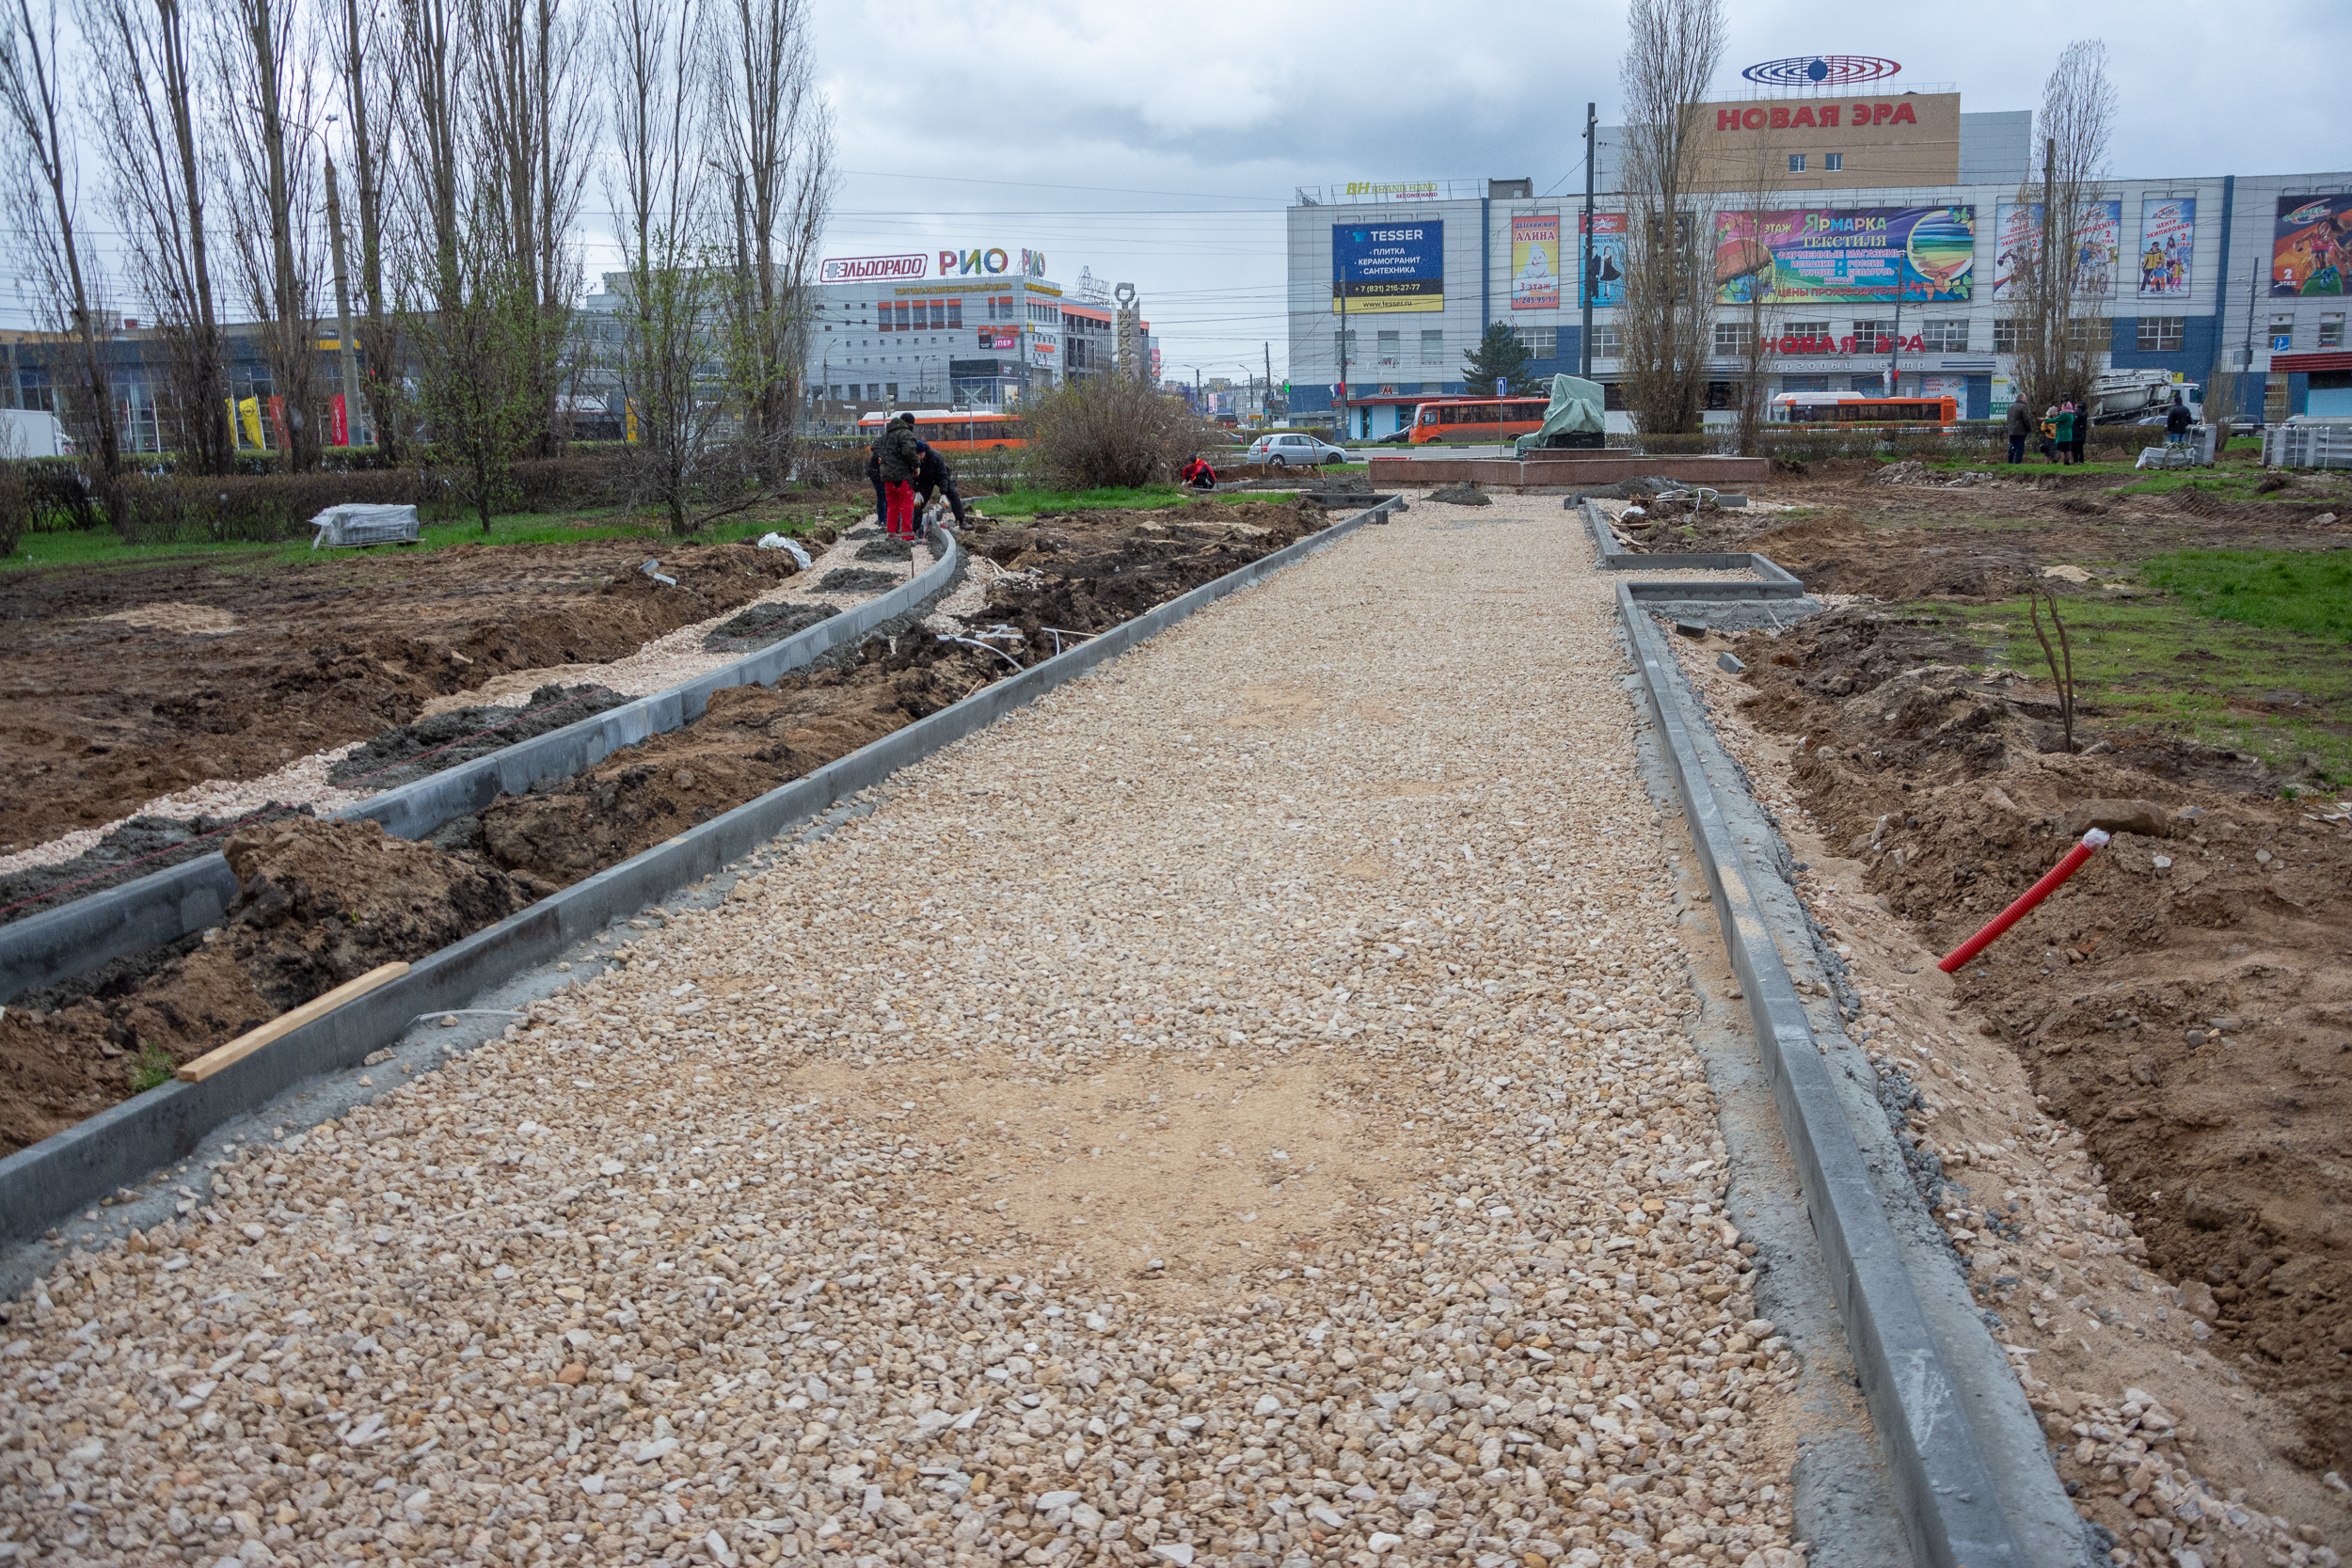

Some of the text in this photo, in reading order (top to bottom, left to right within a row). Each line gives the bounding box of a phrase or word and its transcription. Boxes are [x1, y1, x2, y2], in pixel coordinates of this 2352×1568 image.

[1717, 103, 1917, 131] НОВАЯ ЭРА
[1346, 182, 1438, 195] BH BRAND HAND
[1515, 221, 1542, 230] ДЕТСКИЙ
[1764, 223, 1792, 233] ЭТАЖ
[1801, 214, 1887, 235] ЯРМАРКА
[2146, 222, 2190, 238] ЭКИПИРОВКИ
[2155, 219, 2177, 229] ЦЕНТР
[1371, 230, 1423, 242] TESSER
[1515, 230, 1557, 242] АЛИНА
[1801, 235, 1887, 248] ТЕКСТИЛЯ
[1373, 247, 1406, 256] ПЛИТКА
[1776, 249, 1844, 259] ФИРМЕННЫЕ
[939, 247, 1009, 276] РИО
[1022, 247, 1046, 277] РИО
[1358, 257, 1421, 265] КЕРАМОГРАНИТ
[1363, 266, 1416, 275] САНТЕХНИКА
[2283, 268, 2293, 279] 2
[1824, 275, 1854, 284] КИТАЙ
[1367, 284, 1384, 293] (831)
[1386, 283, 1421, 292] 216-27-77
[1520, 282, 1525, 291] 3
[1778, 284, 1906, 297] ЦЕНЫ ПРОИЗВОДИТЕЛЕЙ
[977, 325, 1021, 338] DNS
[1760, 334, 1927, 354] НОВАЯ ЭРА
